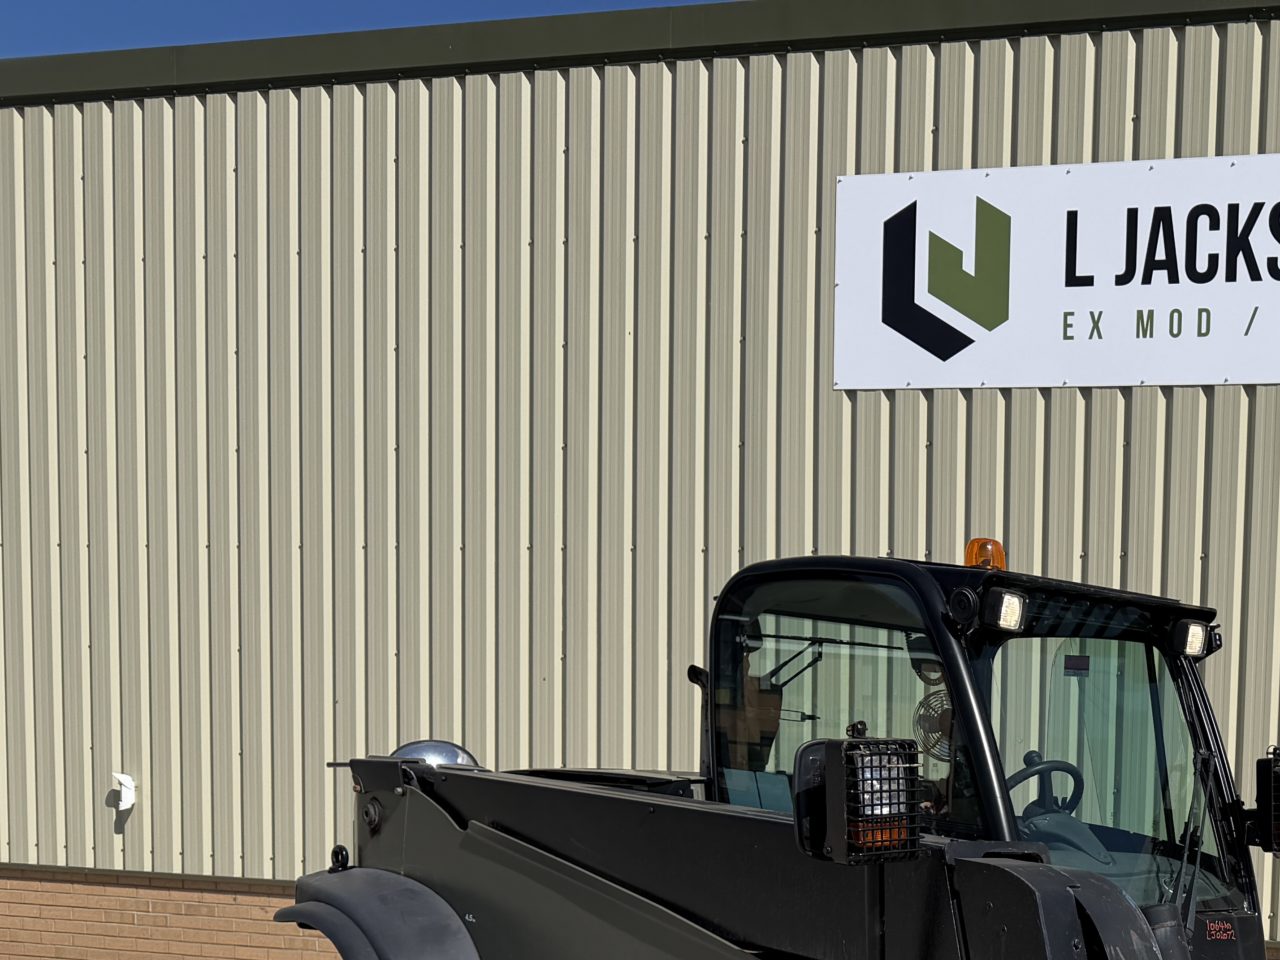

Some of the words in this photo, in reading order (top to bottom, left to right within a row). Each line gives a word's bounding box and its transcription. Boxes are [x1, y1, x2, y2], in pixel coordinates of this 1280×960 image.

[1064, 211, 1095, 287] L
[1062, 311, 1104, 341] EX
[1135, 308, 1211, 339] MOD
